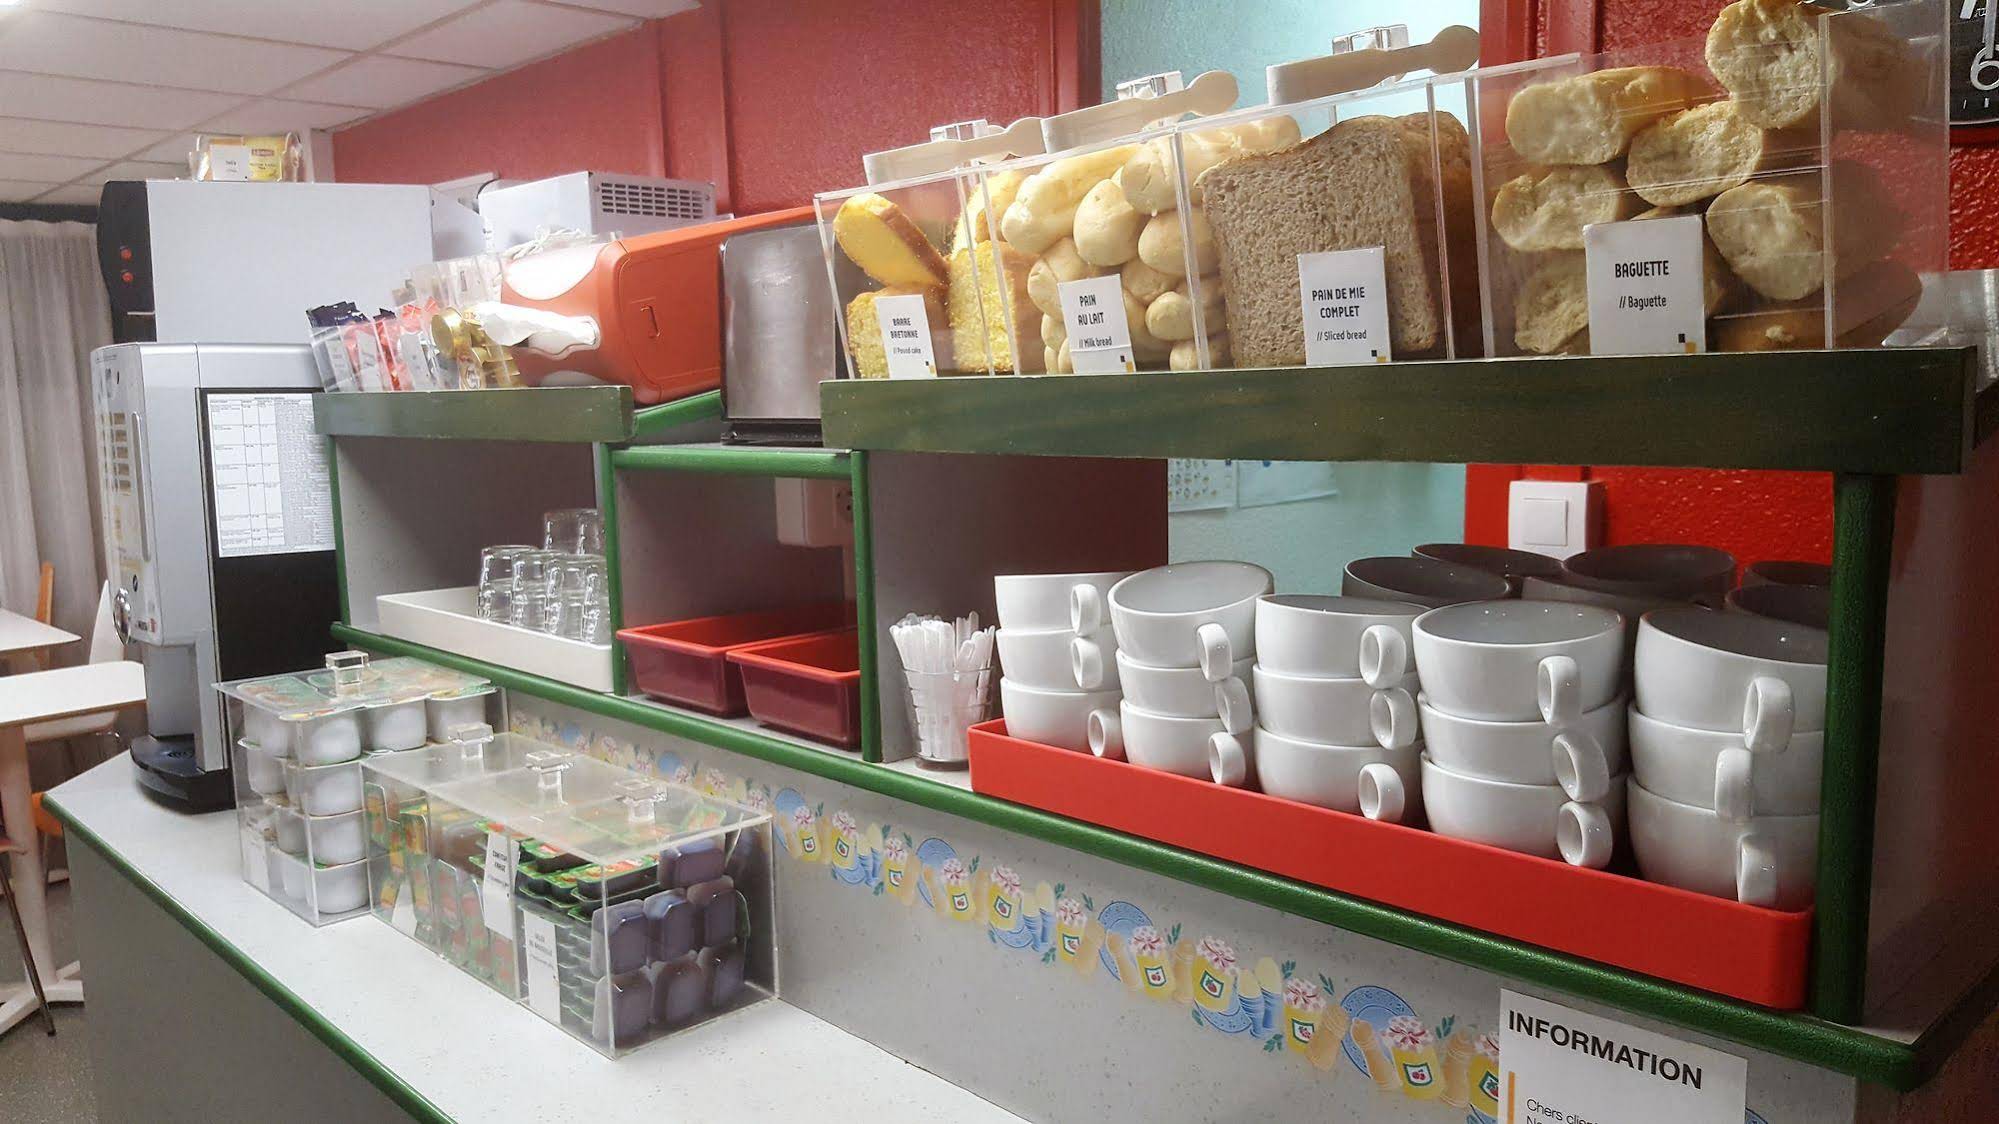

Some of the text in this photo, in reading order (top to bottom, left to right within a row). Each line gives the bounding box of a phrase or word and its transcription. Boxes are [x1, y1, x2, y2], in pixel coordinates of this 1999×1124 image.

[1615, 260, 1670, 278] BAGUETTE
[1079, 294, 1097, 307] PAIN
[1312, 286, 1366, 301] PAIN DE MIE
[1628, 295, 1667, 311] Baguette
[1077, 311, 1104, 326] AU LAIT
[1320, 305, 1360, 319] COMPLET
[892, 317, 911, 327] BARRE
[1084, 337, 1096, 348] Milk
[1096, 335, 1112, 347] bread
[1324, 330, 1345, 341] Sliced
[1346, 329, 1367, 340] bread
[1508, 1010, 1702, 1090] INFORMATION
[1526, 1098, 1563, 1121] Chers
